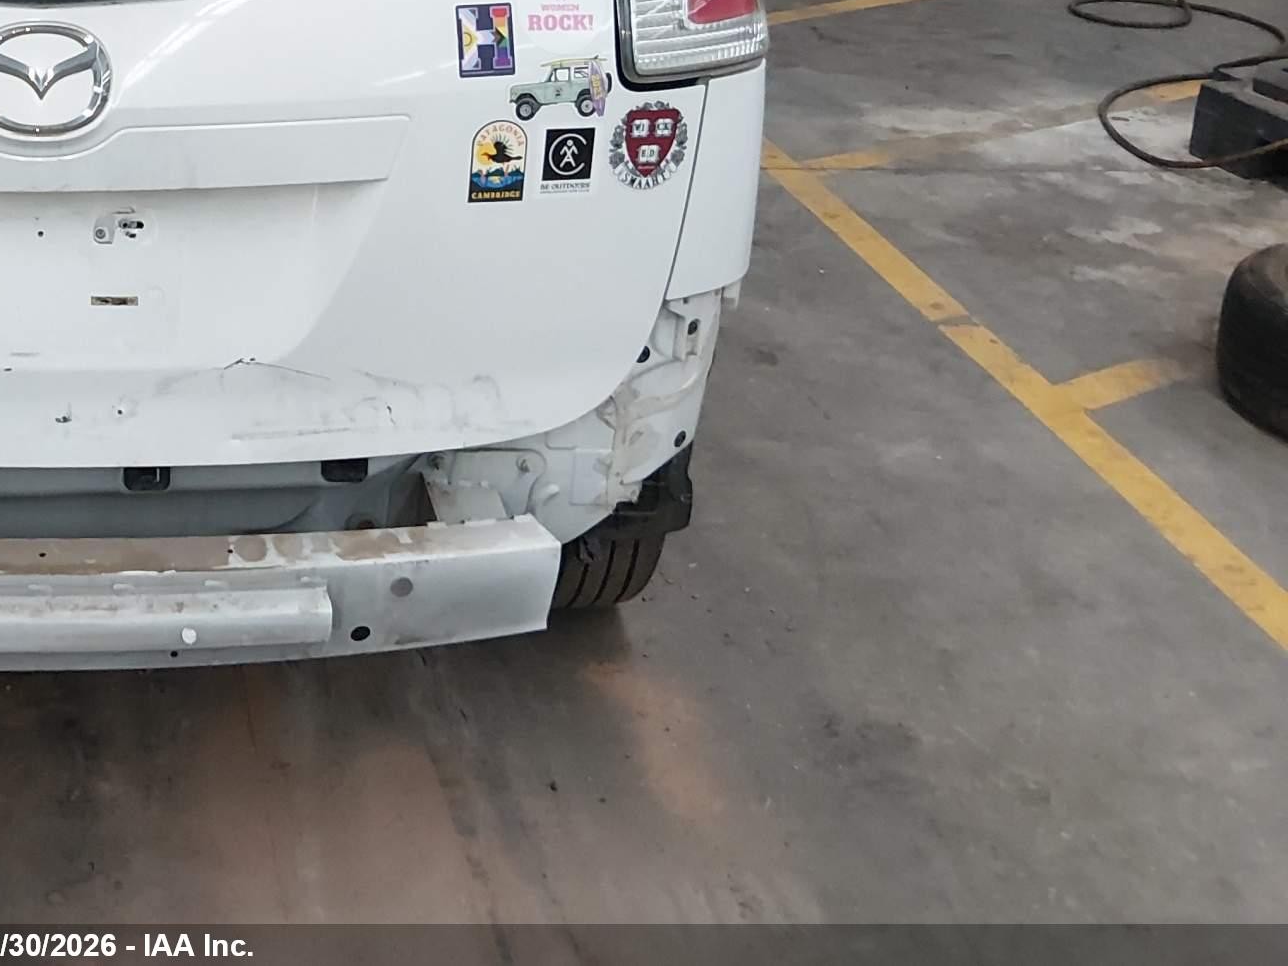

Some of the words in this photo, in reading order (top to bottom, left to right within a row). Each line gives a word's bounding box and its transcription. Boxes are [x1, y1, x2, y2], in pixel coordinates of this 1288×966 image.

[540, 3, 580, 12] WOMEN
[527, 14, 594, 32] ROCK!
[476, 124, 525, 147] PATAGONIA
[471, 190, 521, 200] CAMBRIDGE
